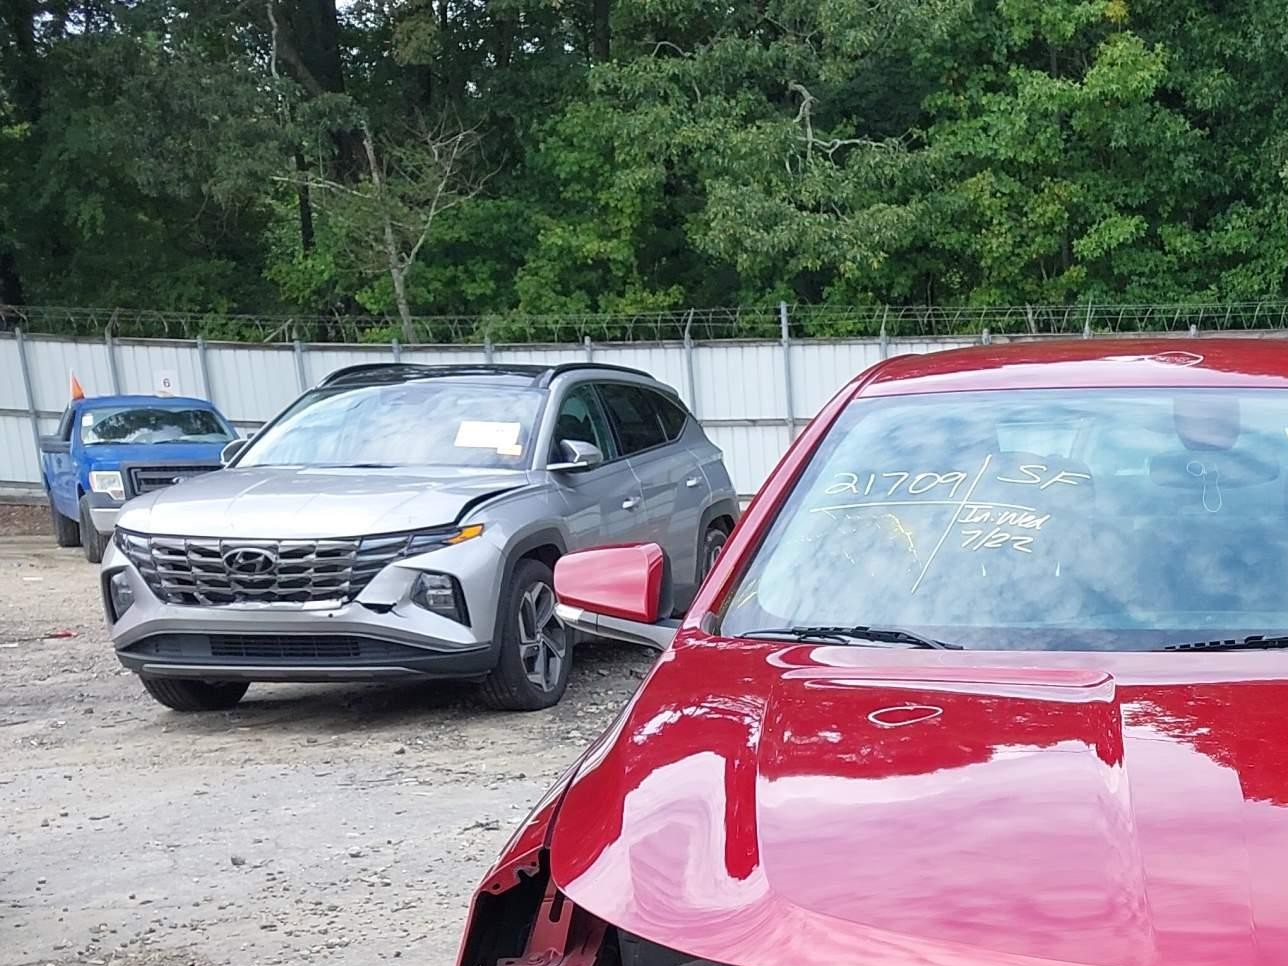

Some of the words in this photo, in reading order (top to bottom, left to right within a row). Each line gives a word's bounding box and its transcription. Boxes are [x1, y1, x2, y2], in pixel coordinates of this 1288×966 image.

[163, 378, 171, 387] 6
[824, 472, 967, 498] 21709
[997, 465, 1091, 490] SF
[961, 527, 1034, 553] 7/22
